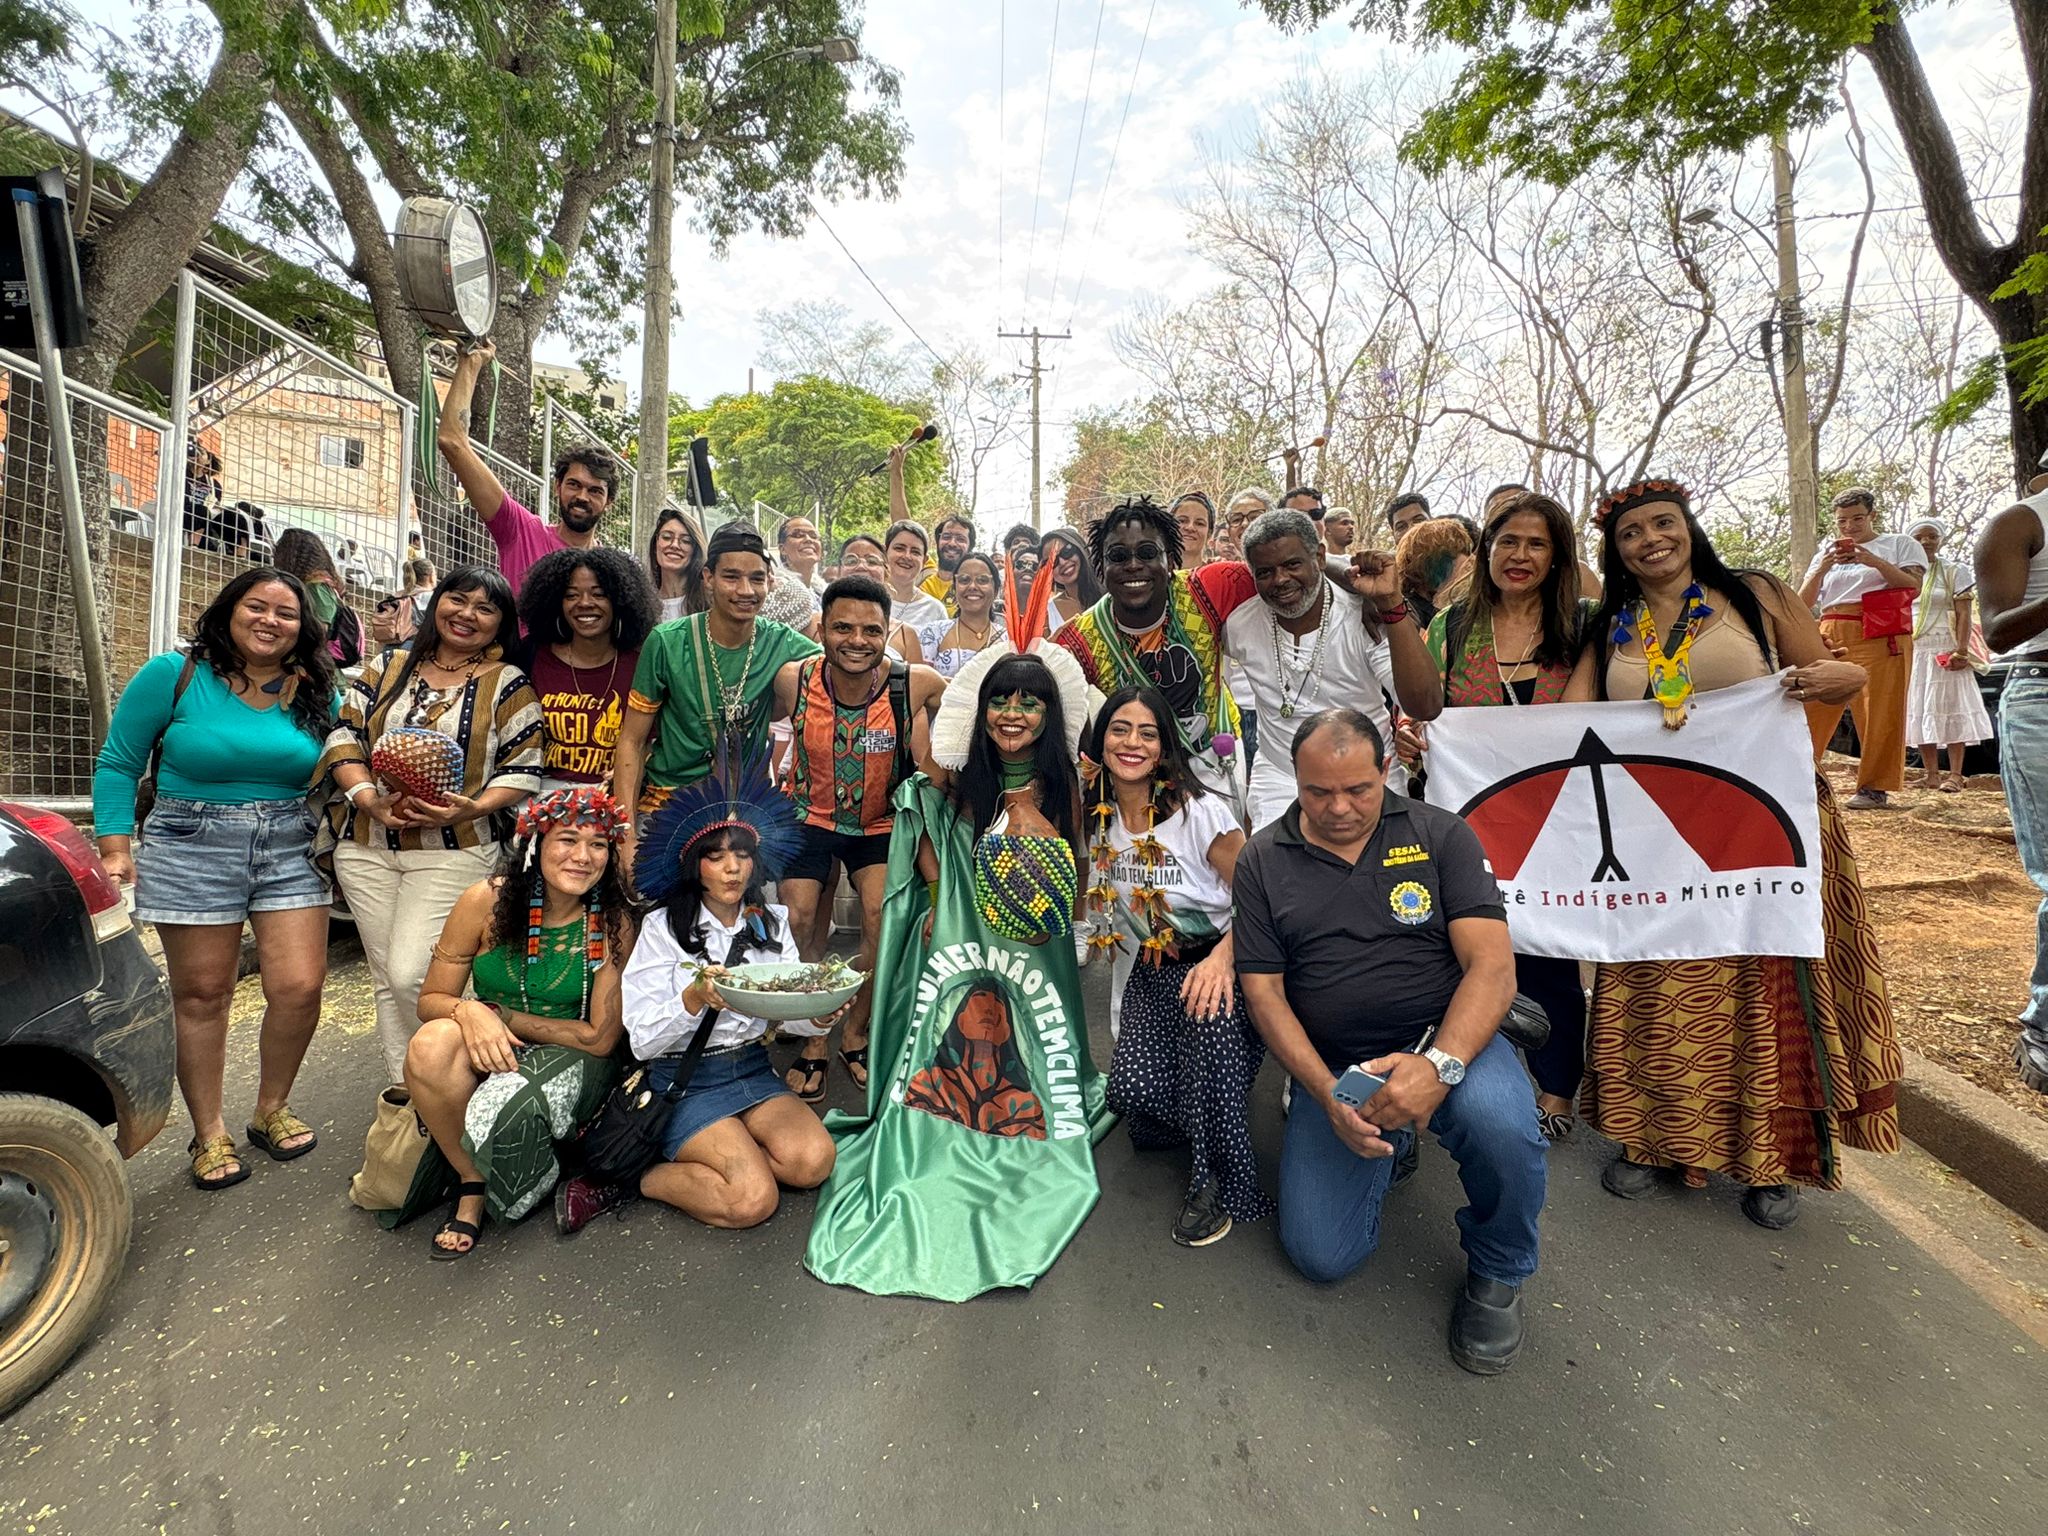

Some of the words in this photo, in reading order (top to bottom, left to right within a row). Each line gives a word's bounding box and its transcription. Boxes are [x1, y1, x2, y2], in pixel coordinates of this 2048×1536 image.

[1112, 853, 1130, 865] EM
[1388, 844, 1421, 857] SESAI
[1110, 863, 1127, 882] NÃO
[1149, 868, 1183, 886] LIMA
[1541, 890, 1667, 910] Indígena
[1682, 877, 1805, 902] Mineiro
[987, 945, 1044, 996] NÃO
[1030, 982, 1071, 1055] TEM
[1046, 1053, 1086, 1140] CLIMA
